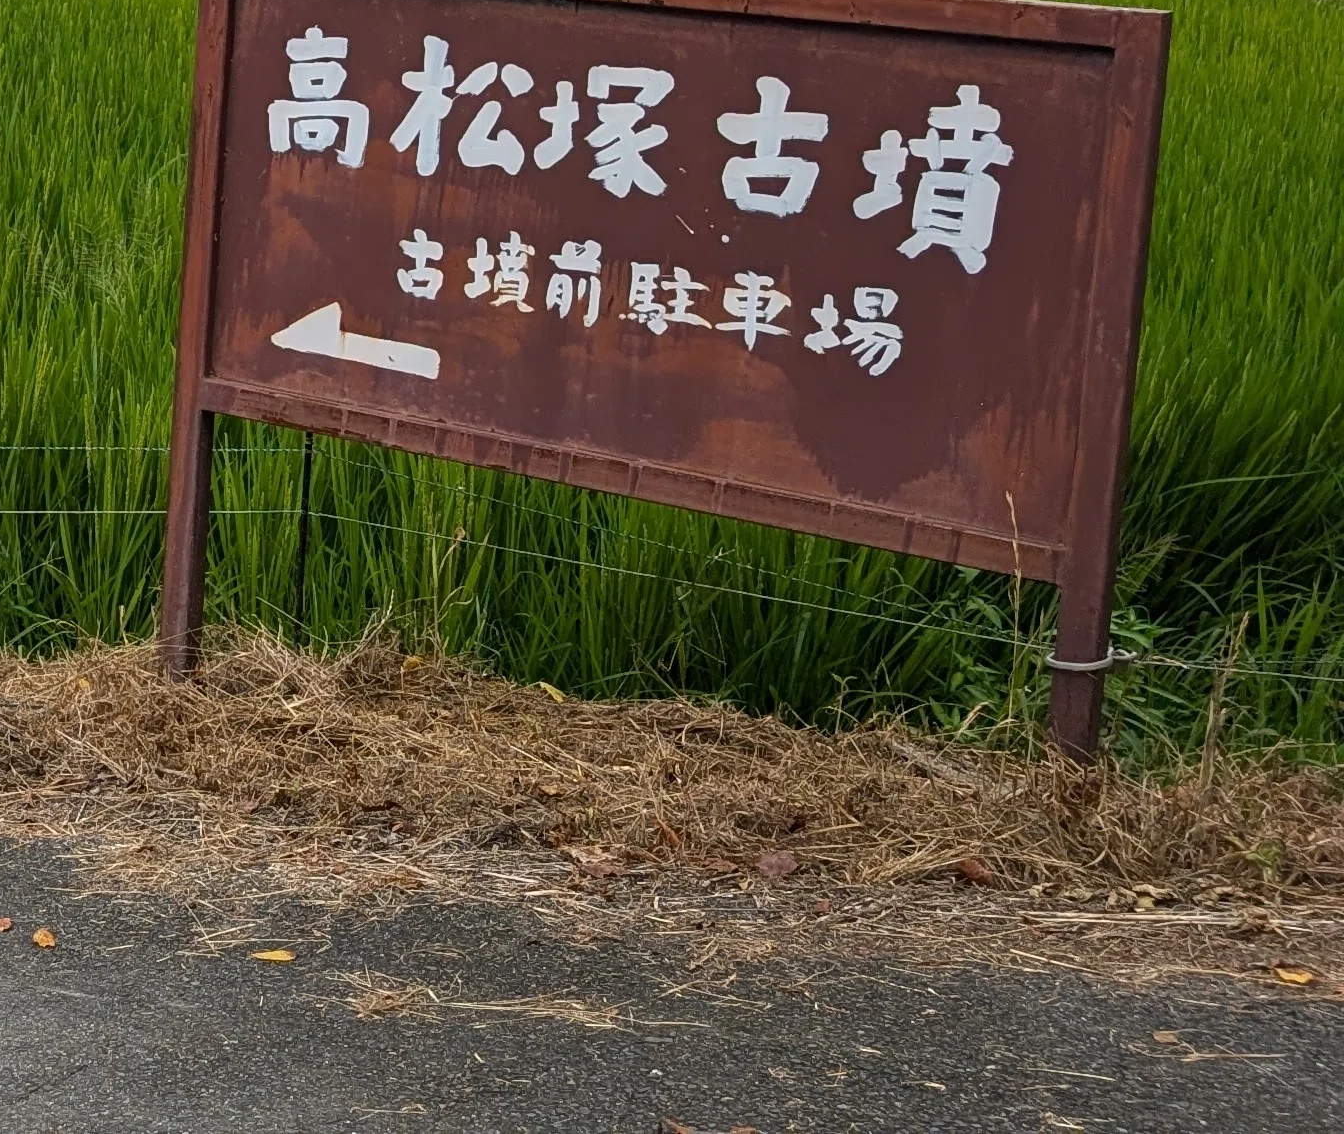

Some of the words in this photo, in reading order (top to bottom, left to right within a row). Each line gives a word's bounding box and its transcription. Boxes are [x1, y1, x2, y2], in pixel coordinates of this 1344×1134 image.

[268, 25, 1014, 274] 高松塚古墳
[397, 230, 903, 376] 古墳前駐車場
